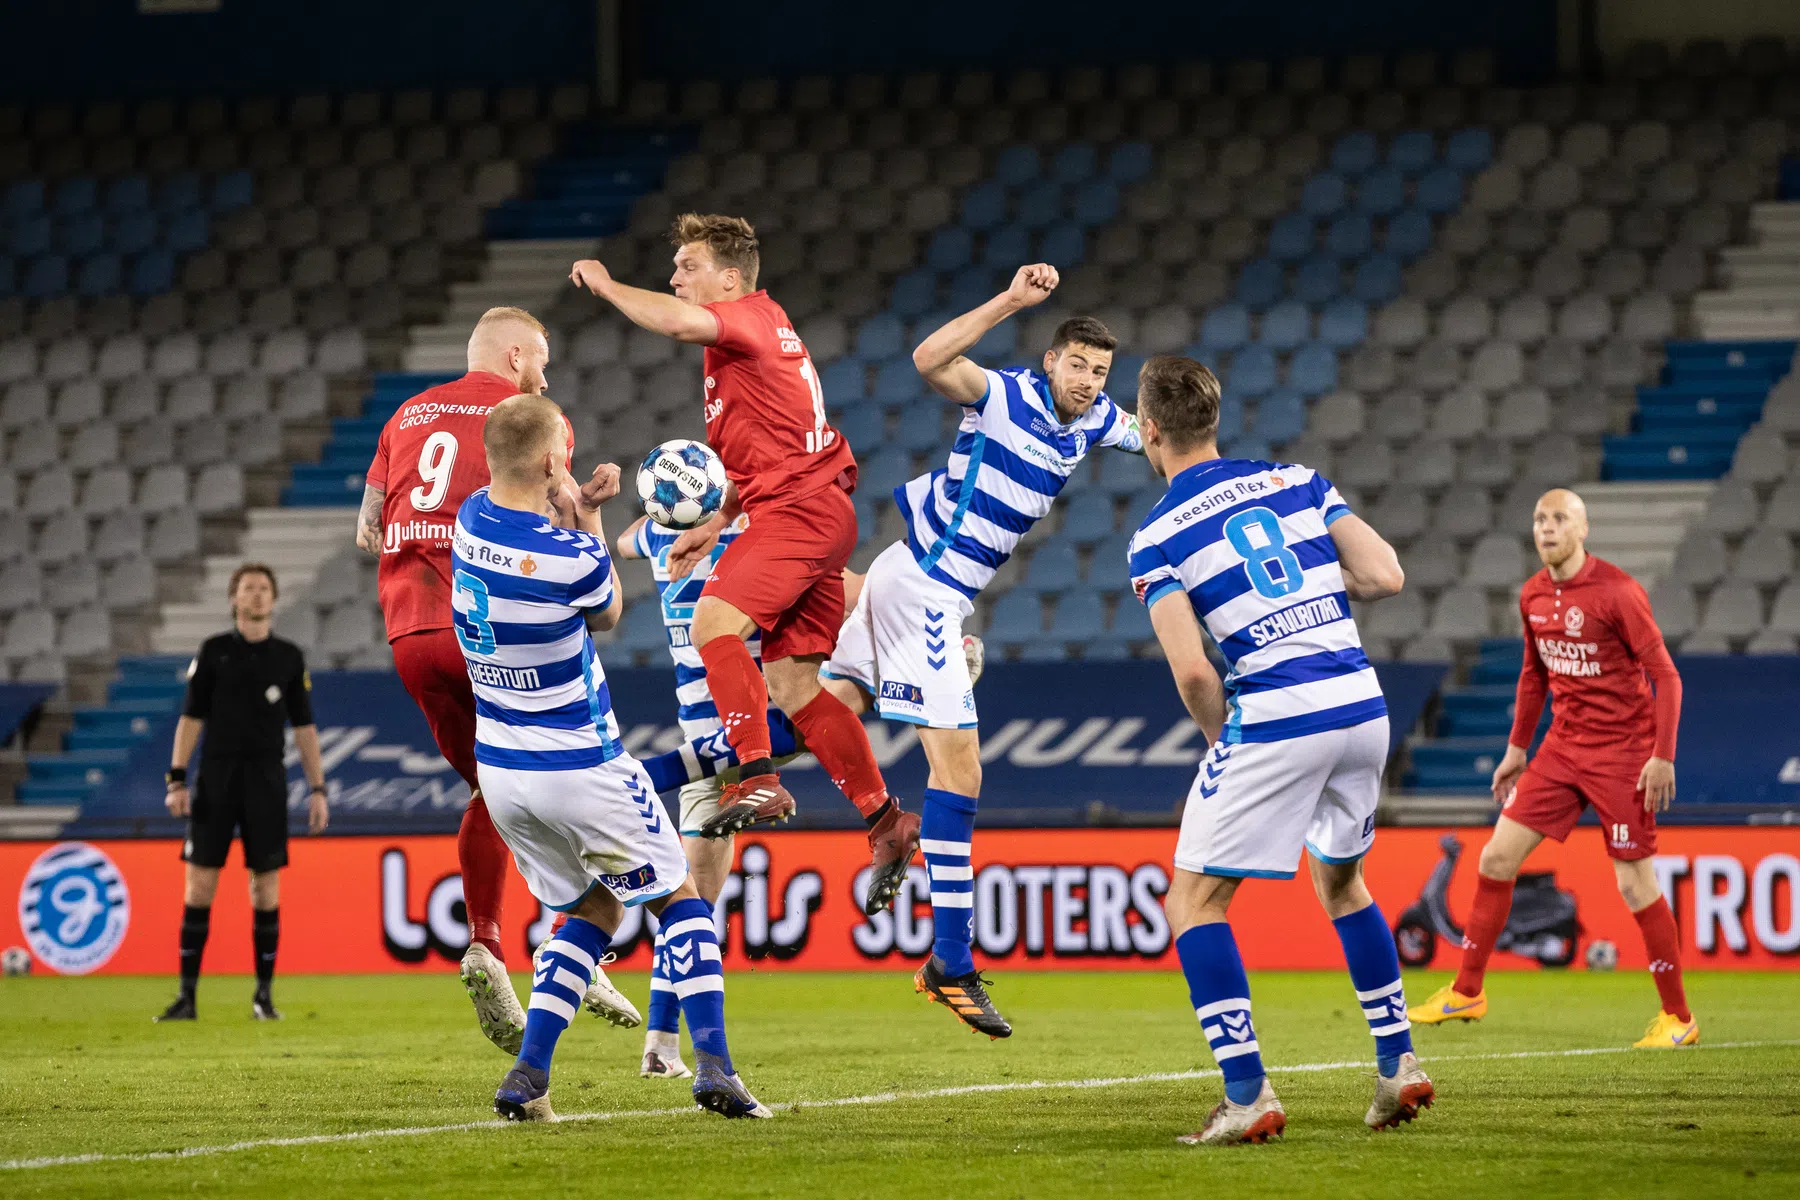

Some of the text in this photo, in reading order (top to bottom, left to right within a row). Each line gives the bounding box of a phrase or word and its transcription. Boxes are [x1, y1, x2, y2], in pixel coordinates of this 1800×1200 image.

[400, 414, 440, 430] GROEP
[1030, 422, 1050, 437] COFFEE
[410, 431, 458, 512] 9
[658, 458, 704, 493] DERBYSTAR
[1173, 481, 1268, 525] seesing flex
[434, 541, 449, 549] we
[479, 546, 513, 568] flex
[1222, 506, 1304, 599] 8
[453, 568, 497, 656] 3
[1249, 595, 1343, 647] SCHUURMAN
[469, 661, 540, 689] HEERTUM
[883, 682, 905, 698] JPR
[607, 875, 632, 889] JPR
[852, 864, 1171, 955] SCOTERS
